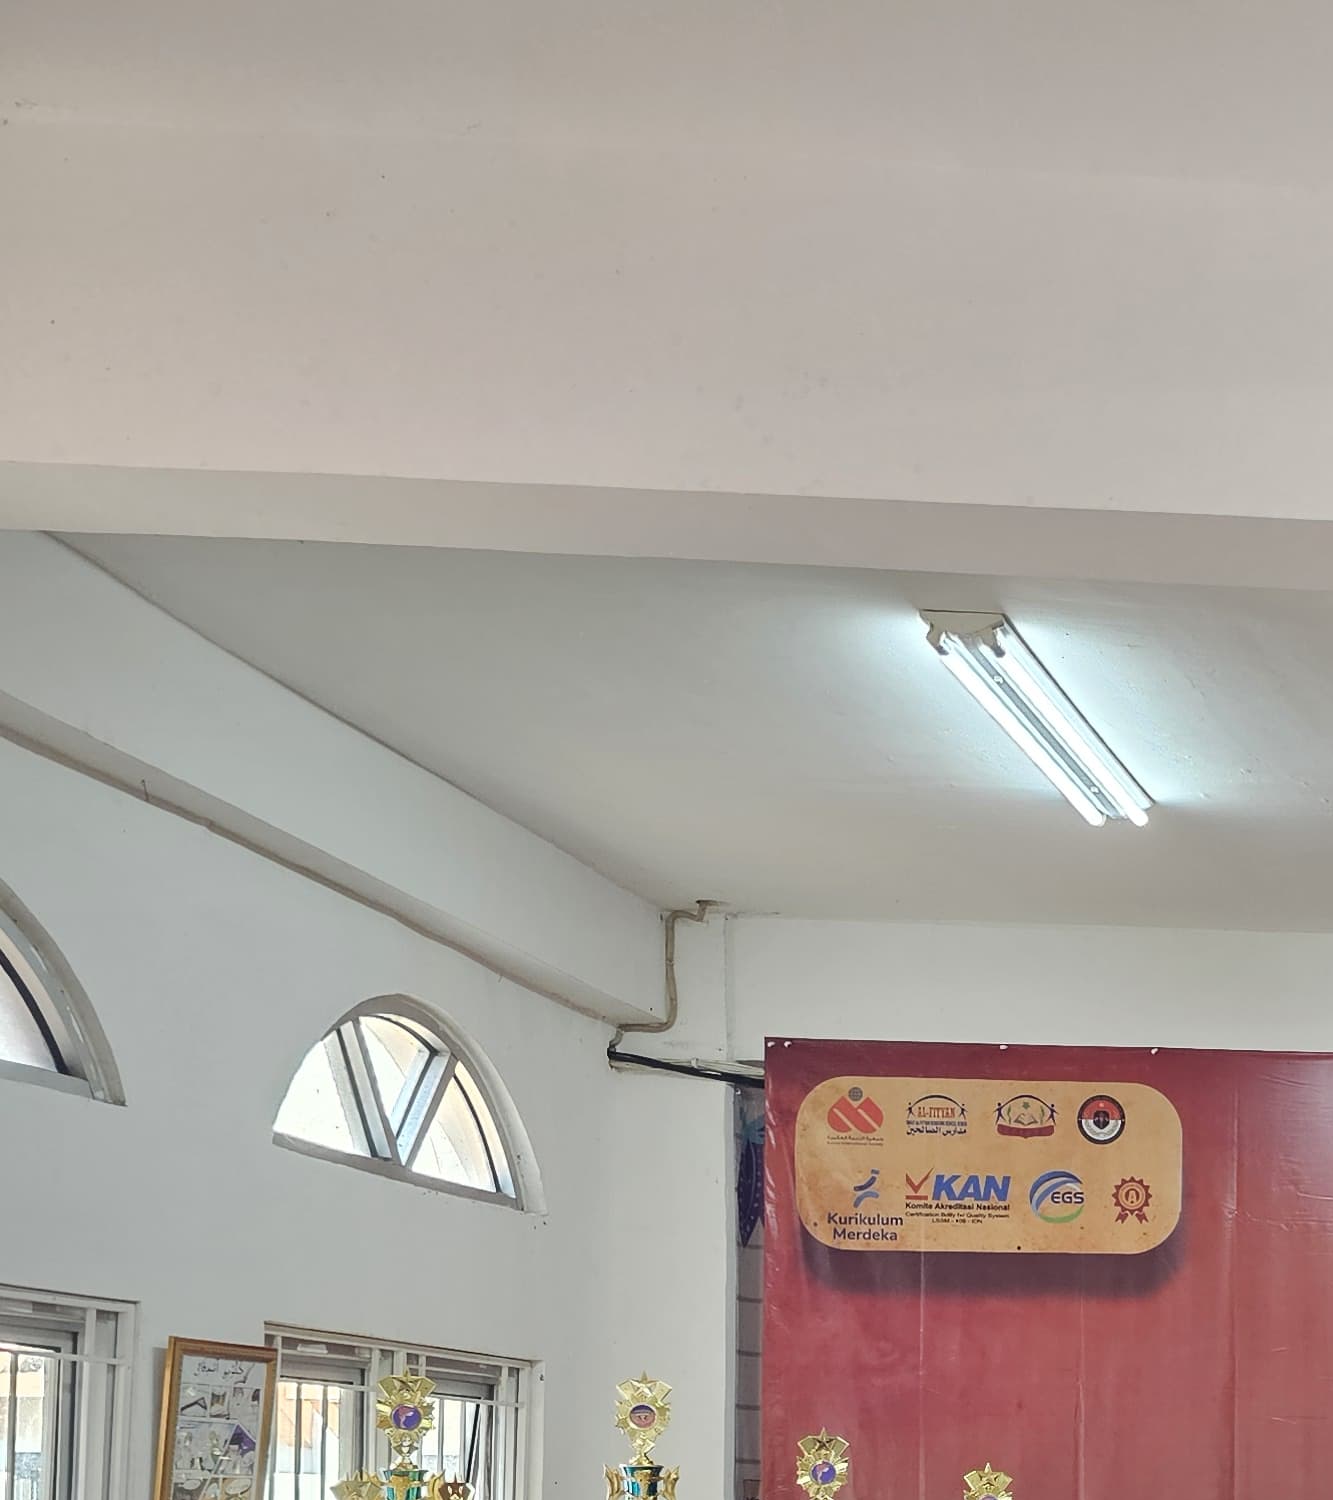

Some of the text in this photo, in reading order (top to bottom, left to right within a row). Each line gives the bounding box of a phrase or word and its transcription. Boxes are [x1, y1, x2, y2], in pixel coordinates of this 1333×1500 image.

[932, 1174, 1011, 1201] KAN
[1051, 1191, 1084, 1204] EGS
[905, 1202, 933, 1210] Komite
[828, 1212, 904, 1226] Kurikulum
[833, 1228, 898, 1242] Merdeka
